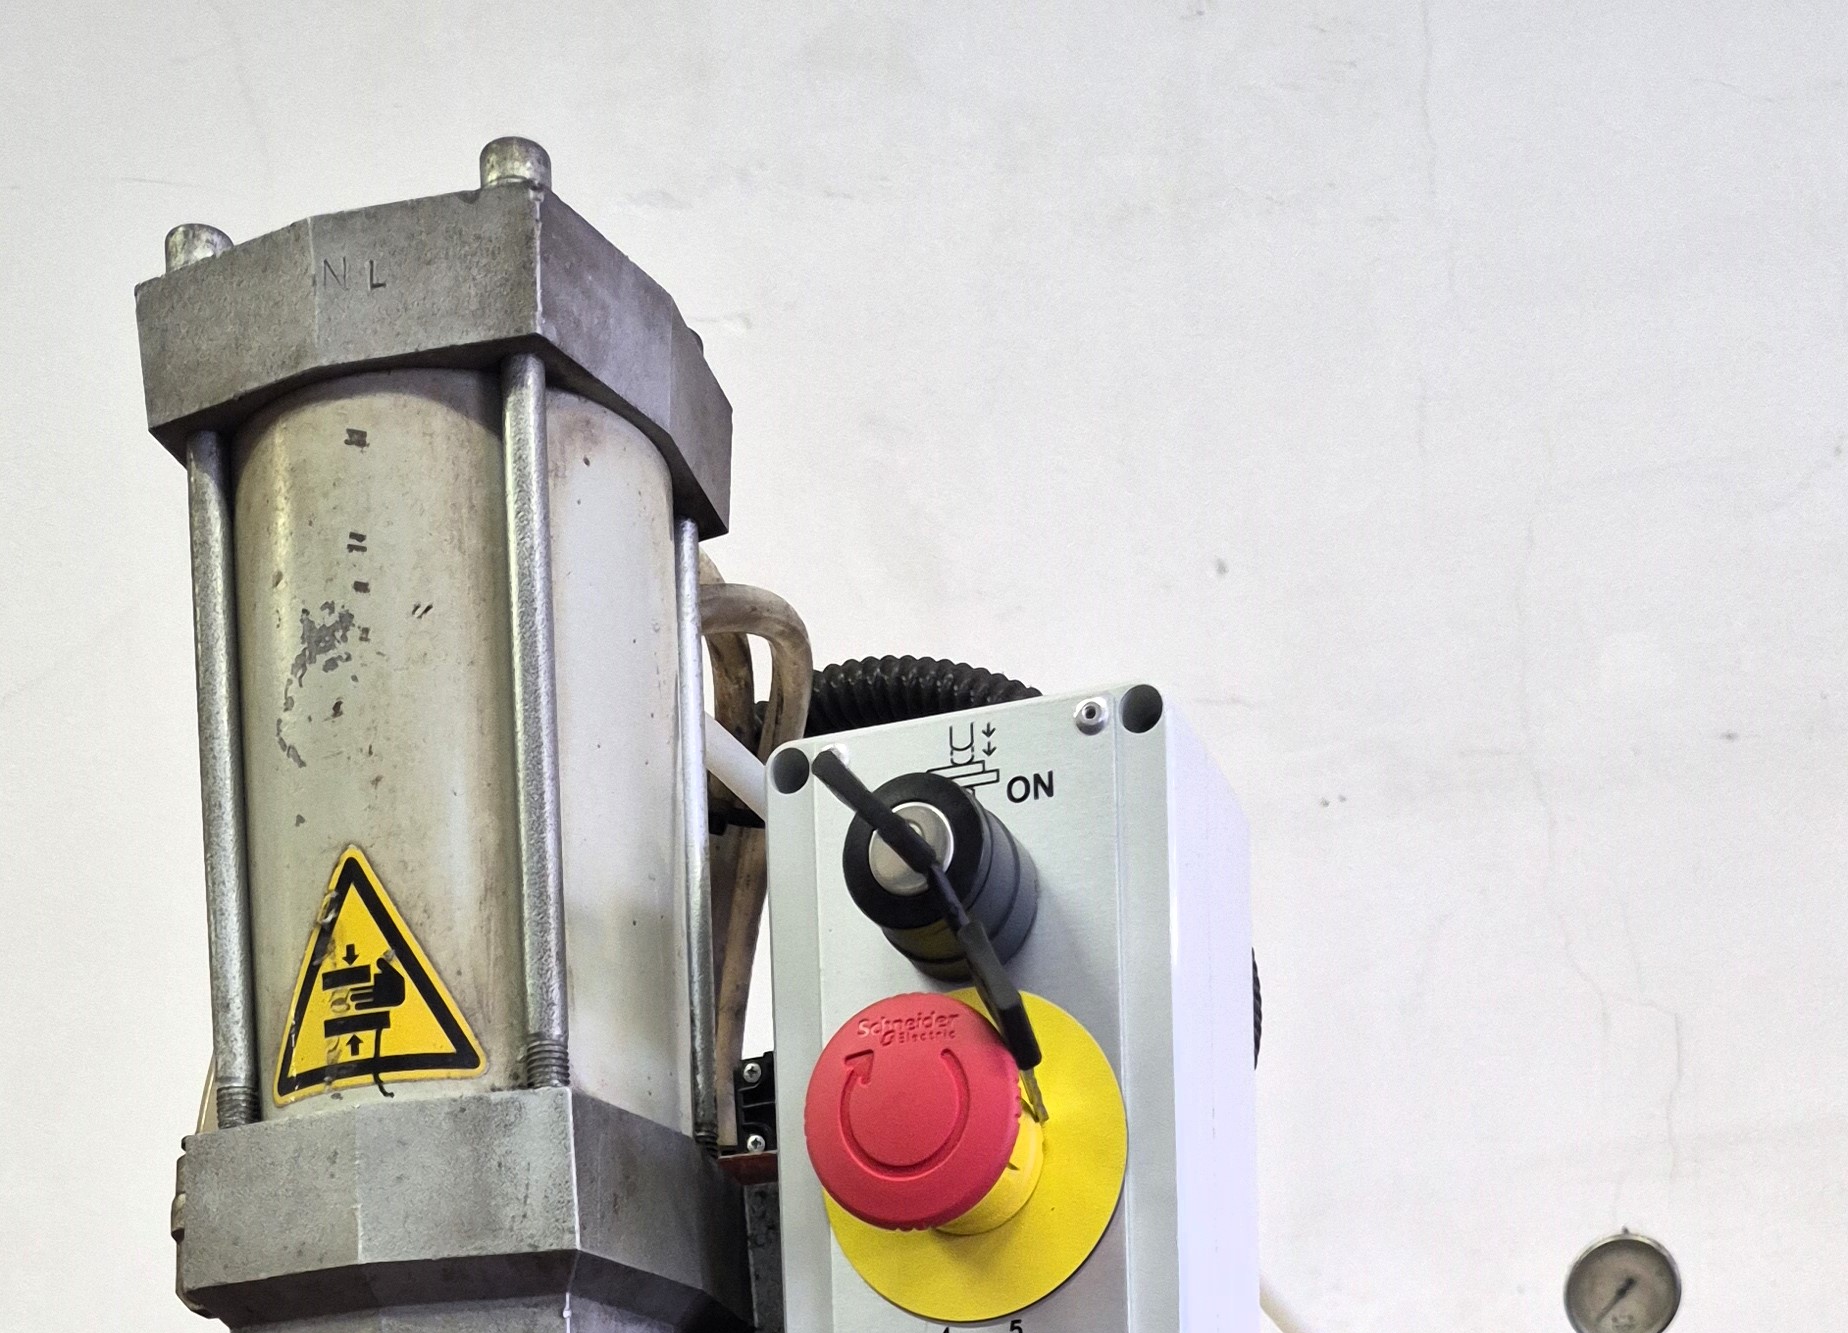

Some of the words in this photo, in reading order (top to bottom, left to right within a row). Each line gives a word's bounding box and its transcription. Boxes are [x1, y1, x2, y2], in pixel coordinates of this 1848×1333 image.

[1006, 770, 1054, 803] ON
[857, 1010, 960, 1038] Schneider
[899, 1029, 956, 1044] Electric
